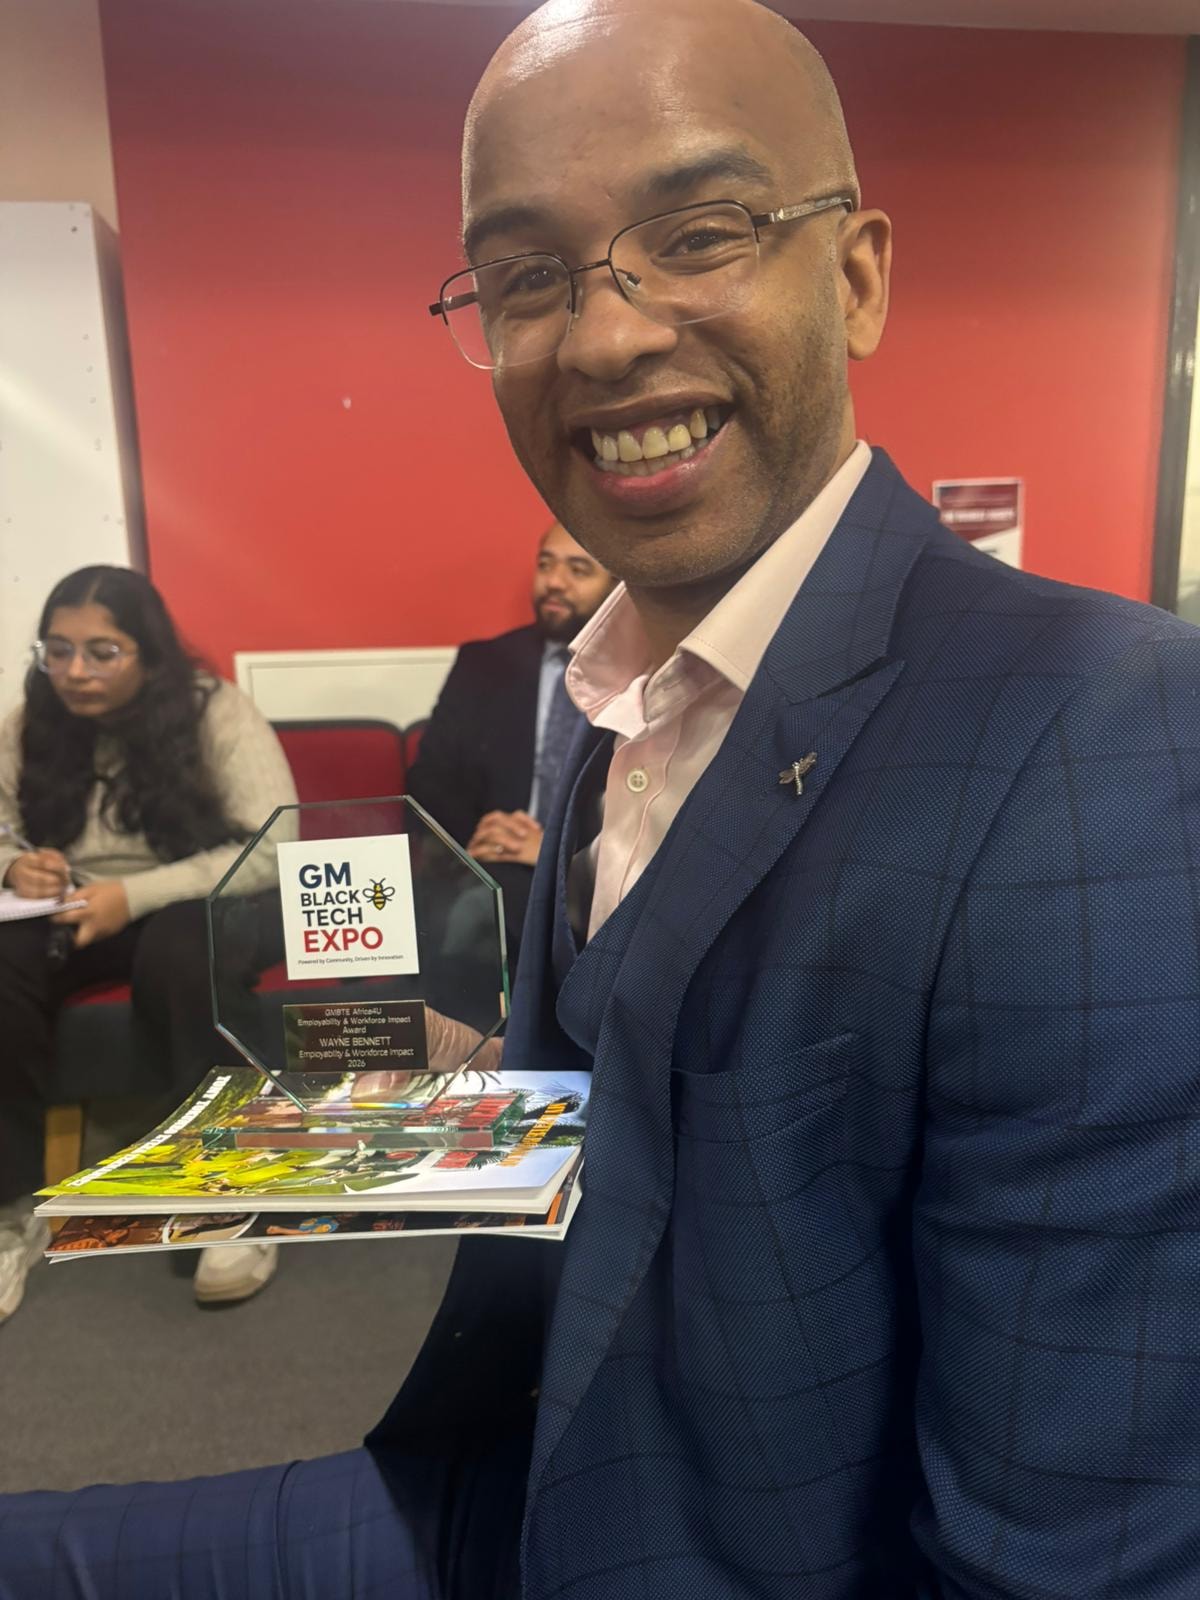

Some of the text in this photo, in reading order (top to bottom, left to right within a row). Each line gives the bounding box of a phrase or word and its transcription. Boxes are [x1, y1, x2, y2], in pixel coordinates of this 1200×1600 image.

[298, 862, 352, 889] GM
[300, 889, 361, 907] BLACK
[302, 906, 364, 928] TECH
[303, 926, 384, 953] EXPO
[297, 1015, 411, 1027] Employability & Workforce Impact
[342, 1026, 367, 1034] Award
[319, 1036, 392, 1047] WAYNE BENNETT
[344, 1048, 351, 1058] &
[351, 1048, 388, 1057] Workforce
[389, 1048, 415, 1058] Impact
[347, 1059, 367, 1068] 2026
